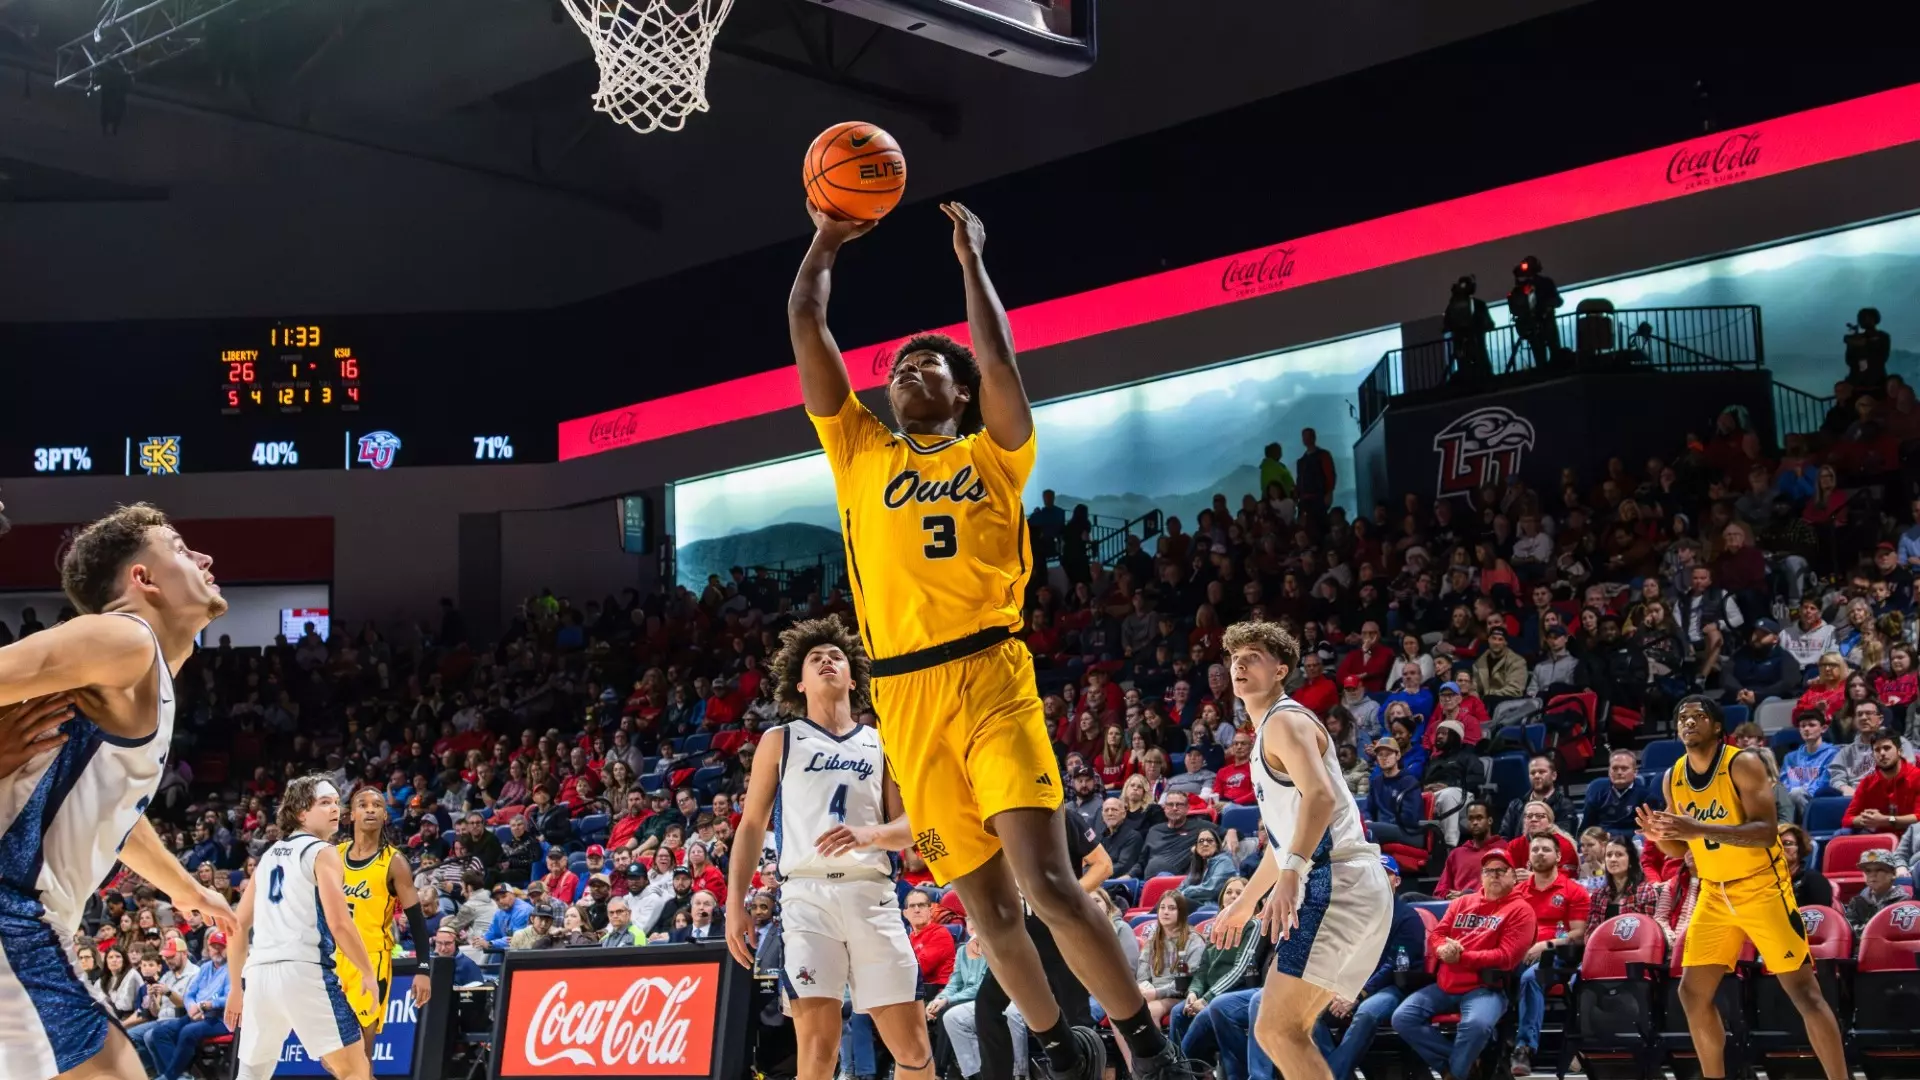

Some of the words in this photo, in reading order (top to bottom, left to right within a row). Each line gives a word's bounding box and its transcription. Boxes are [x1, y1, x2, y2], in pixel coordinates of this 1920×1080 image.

[1666, 131, 1762, 184] Coca-Cola
[1222, 246, 1297, 291] Coca-Cola
[271, 326, 320, 347] 11:33
[222, 350, 258, 362] LIBERTY
[334, 348, 351, 358] KSU
[229, 363, 254, 382] 26
[292, 364, 297, 378] 1
[341, 359, 359, 379] 16
[228, 390, 239, 406] 5
[251, 390, 262, 405] 4
[279, 388, 295, 405] 12
[322, 387, 332, 404] 3
[348, 387, 359, 402] 4
[34, 446, 91, 471] 3PT%
[252, 440, 297, 465] 40%
[473, 436, 513, 460] 71%
[884, 464, 988, 510] Owls
[922, 515, 958, 560] 3
[804, 752, 874, 780] Liberty
[828, 783, 849, 824] 4
[268, 864, 285, 905] 0
[343, 880, 370, 899] wls
[525, 975, 702, 1067] Coca-Cola
